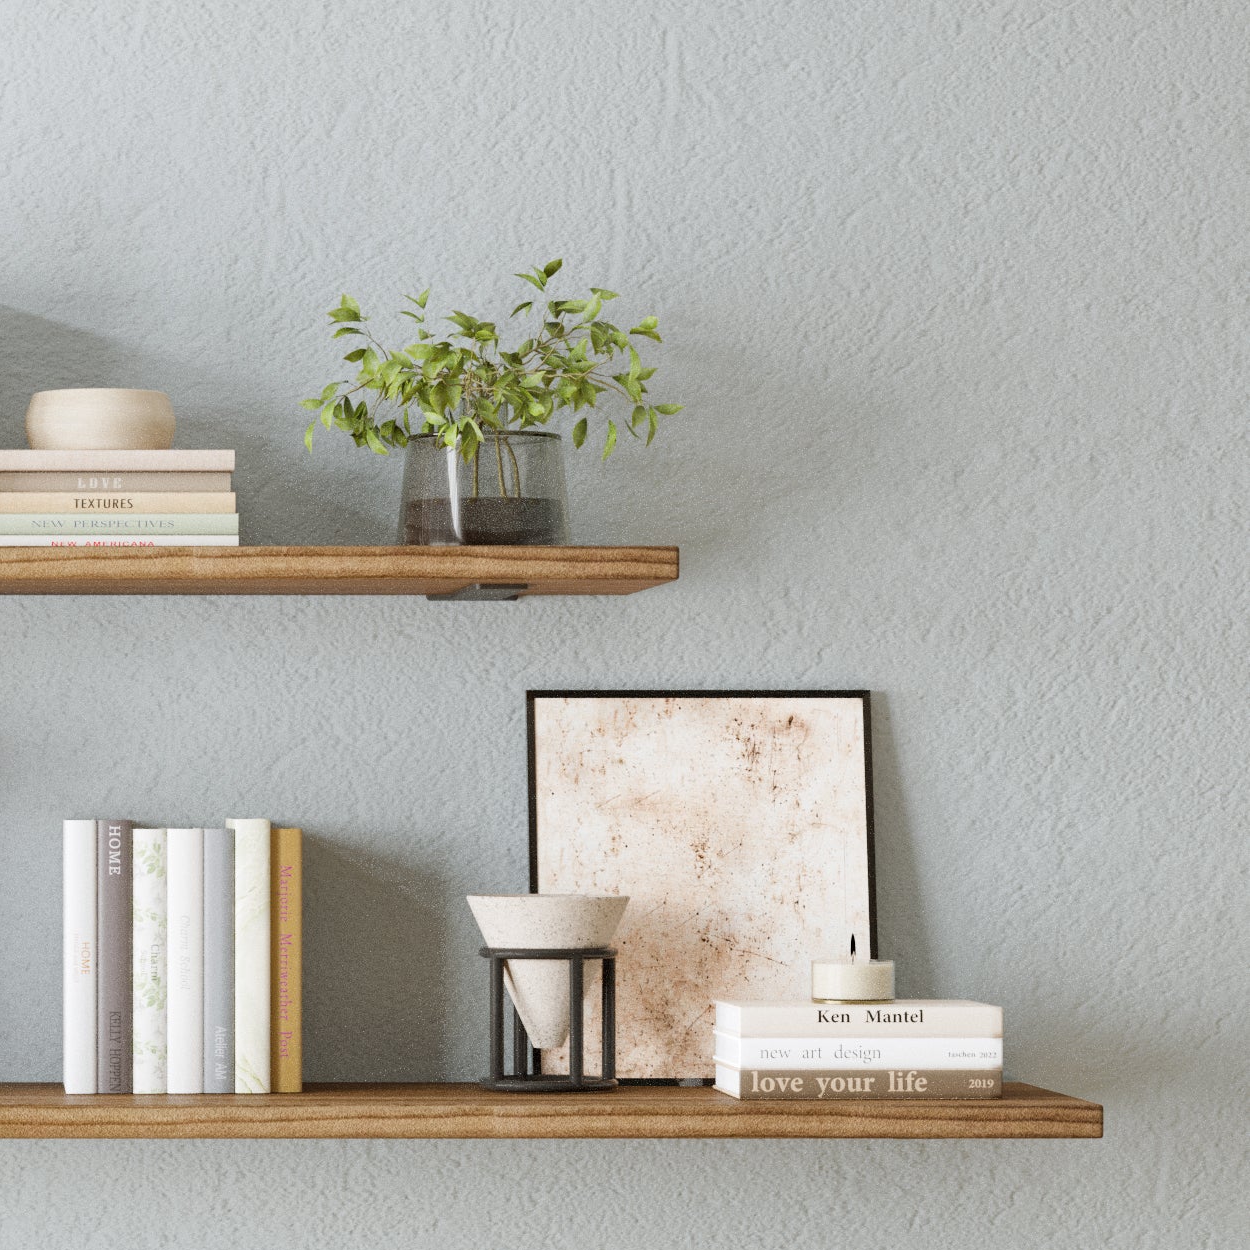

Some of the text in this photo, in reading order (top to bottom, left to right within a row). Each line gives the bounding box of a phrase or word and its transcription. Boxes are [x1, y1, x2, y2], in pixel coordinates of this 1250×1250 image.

[77, 477, 123, 489] LOVE
[73, 498, 133, 509] TEXTURES
[31, 520, 175, 528] NEW PERSPECTIVES
[108, 825, 121, 876] HOME
[81, 941, 91, 976] HOME
[278, 865, 293, 1059] Marjorie Merriweather Post
[817, 1009, 924, 1023] Ken Mantel
[108, 1010, 121, 1093] KELLY HOPPEN
[214, 1025, 228, 1080] Atelier AM
[760, 1044, 881, 1064] new art design
[751, 1070, 928, 1098] love your life
[968, 1078, 994, 1089] 2019
